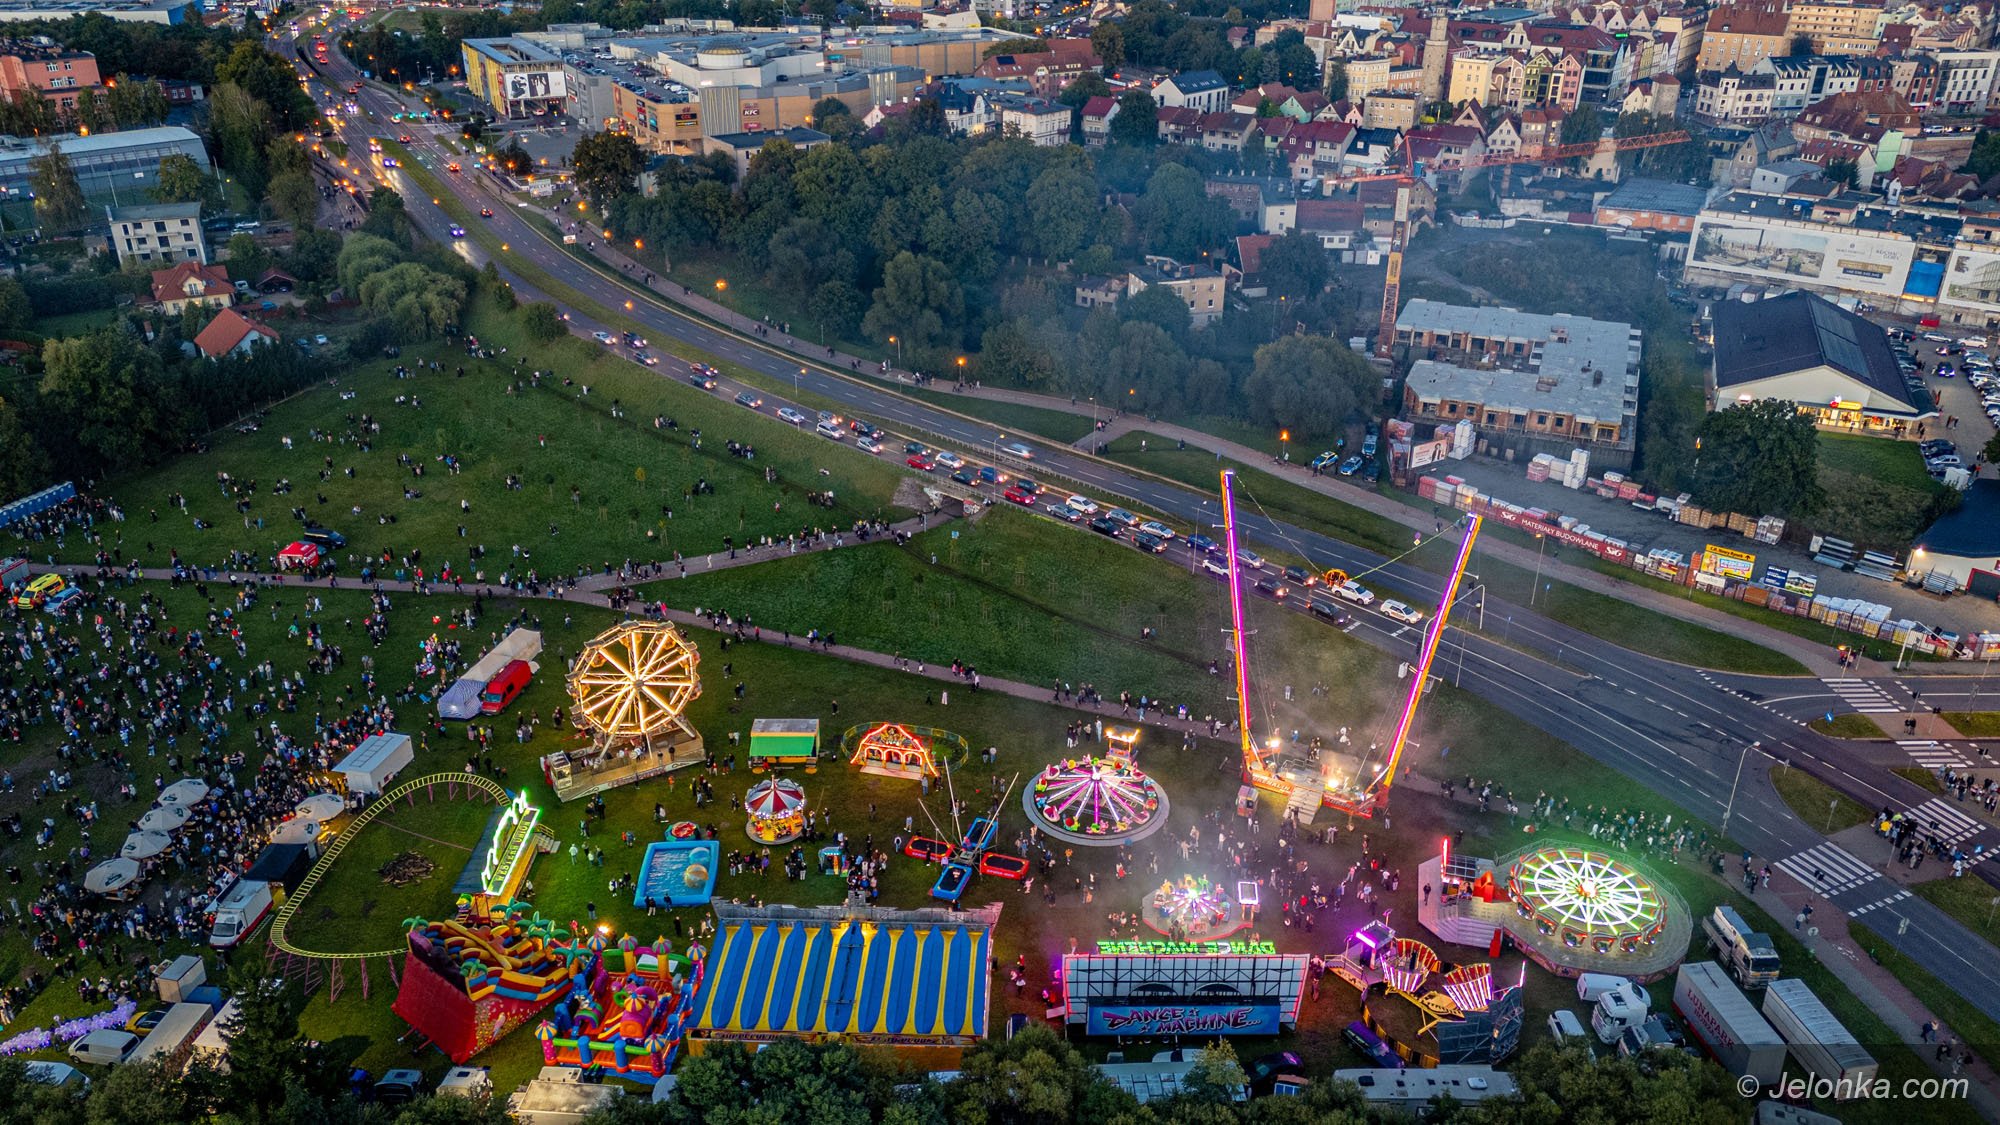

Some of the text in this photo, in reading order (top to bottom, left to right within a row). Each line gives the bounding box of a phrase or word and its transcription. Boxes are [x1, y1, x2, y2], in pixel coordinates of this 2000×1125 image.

[1521, 519, 1599, 550] MATERIAŁY BUDOWLANE
[495, 821, 531, 882] WESTERN UNION
[1101, 1007, 1184, 1030] DANCE
[1687, 988, 1735, 1049] LUNAPARK
